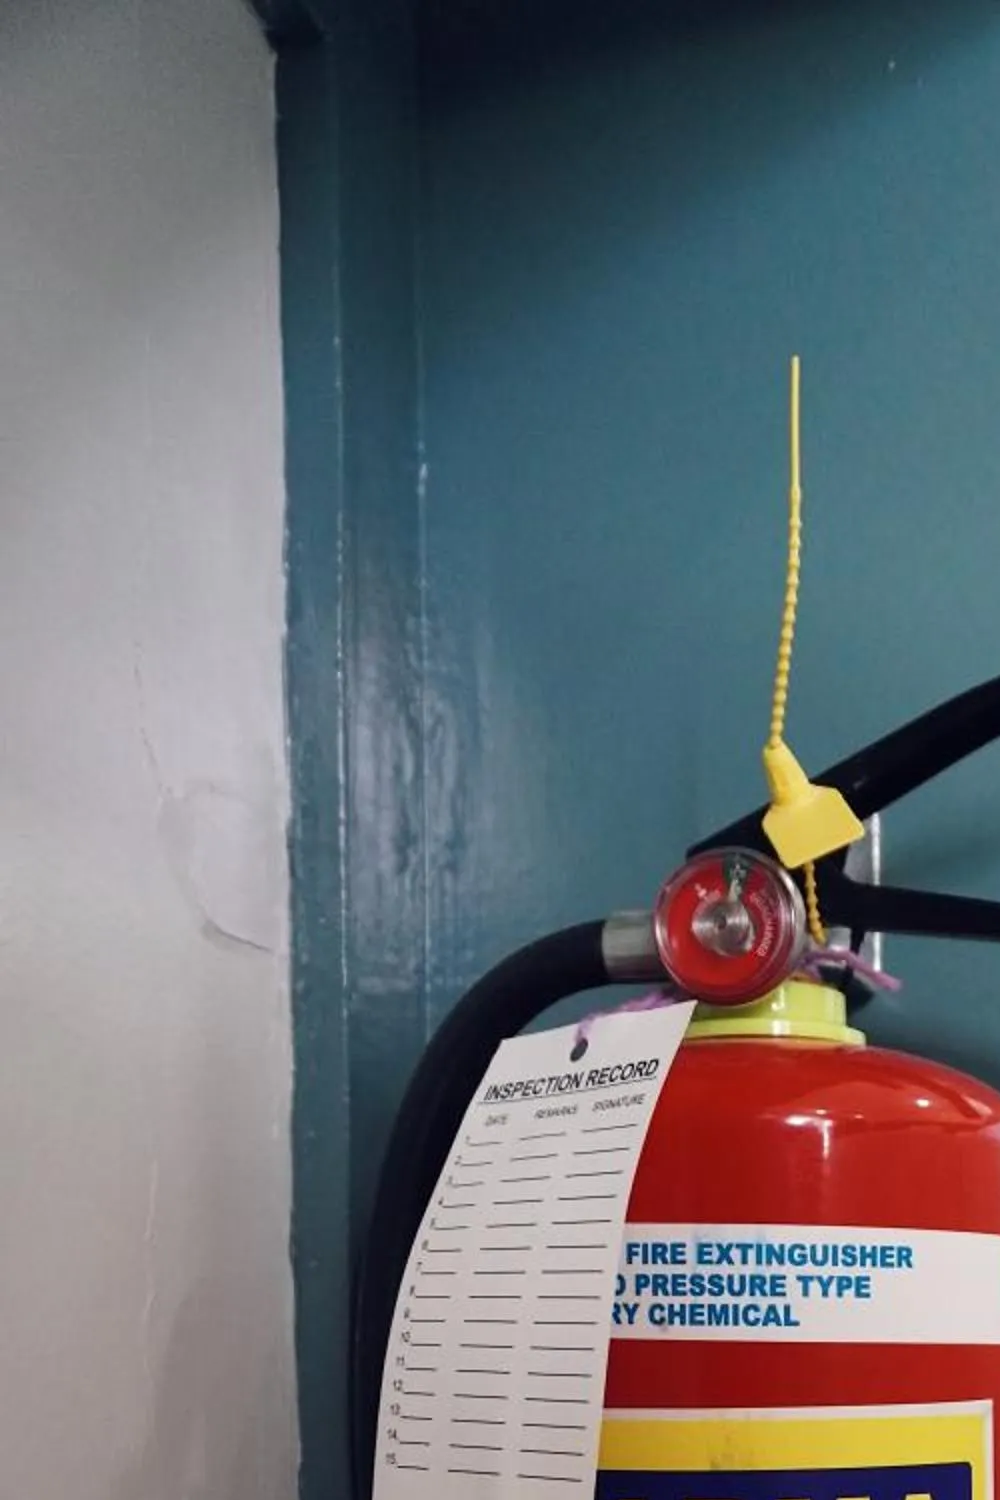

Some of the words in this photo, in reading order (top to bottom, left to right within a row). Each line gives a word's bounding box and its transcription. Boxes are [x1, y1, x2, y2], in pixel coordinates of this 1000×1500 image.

[484, 1073, 583, 1101] INSPECTION
[586, 1059, 660, 1085] RECORD
[592, 1093, 647, 1112] SIGNATURE
[626, 1243, 687, 1265] FIRE
[696, 1243, 913, 1269] EXTINGUISHER
[635, 1274, 787, 1297] PRESSURE
[796, 1275, 872, 1299] TYPE
[648, 1303, 800, 1328] CHEMICAL
